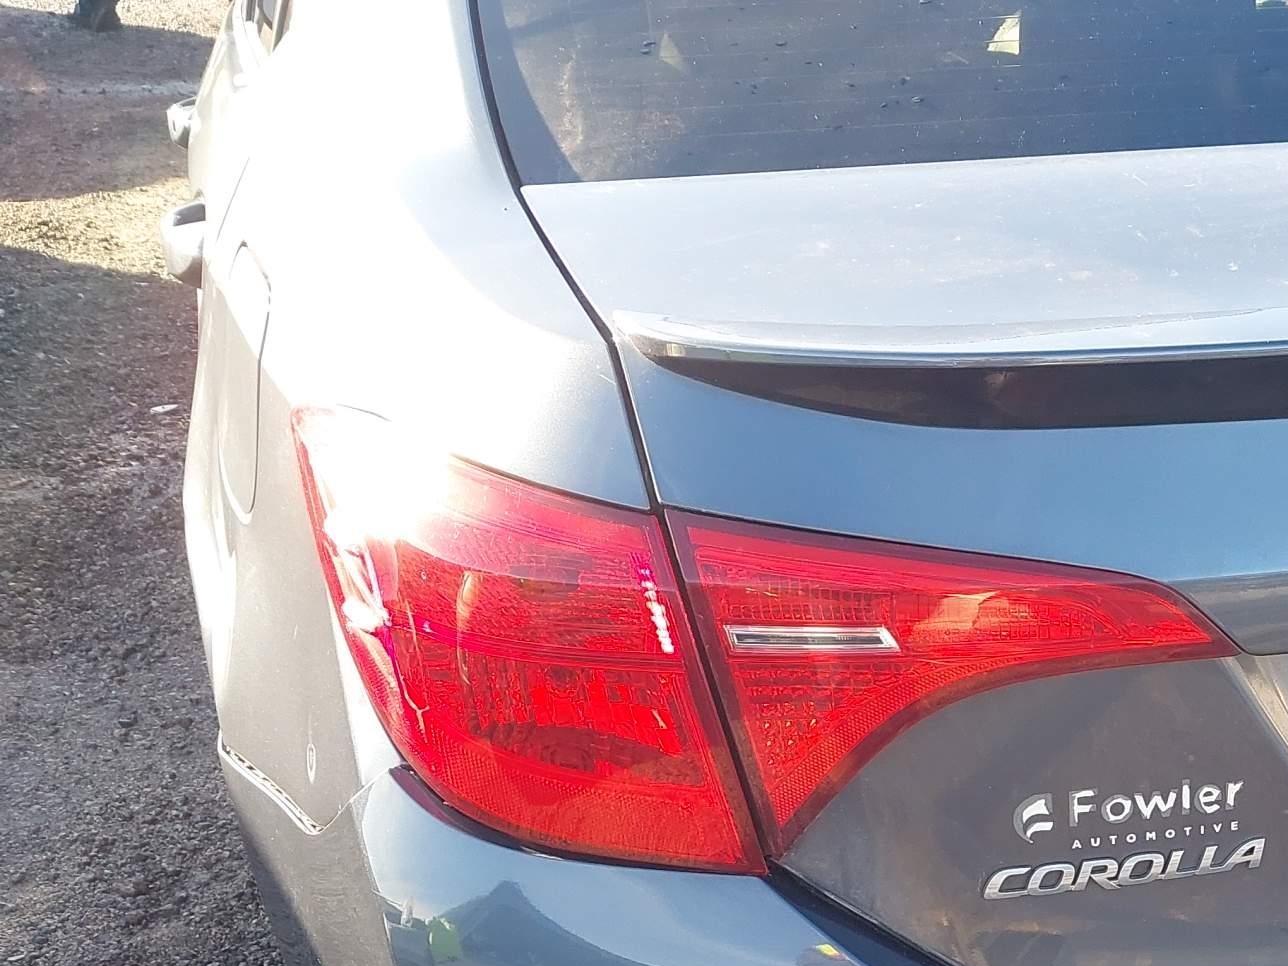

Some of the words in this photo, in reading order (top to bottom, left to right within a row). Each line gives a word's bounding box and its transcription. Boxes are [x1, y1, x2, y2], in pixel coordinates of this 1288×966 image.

[1069, 779, 1244, 826] Fowler
[1071, 820, 1240, 849] AUTOMOTIVE
[983, 837, 1266, 900] COROLLA
